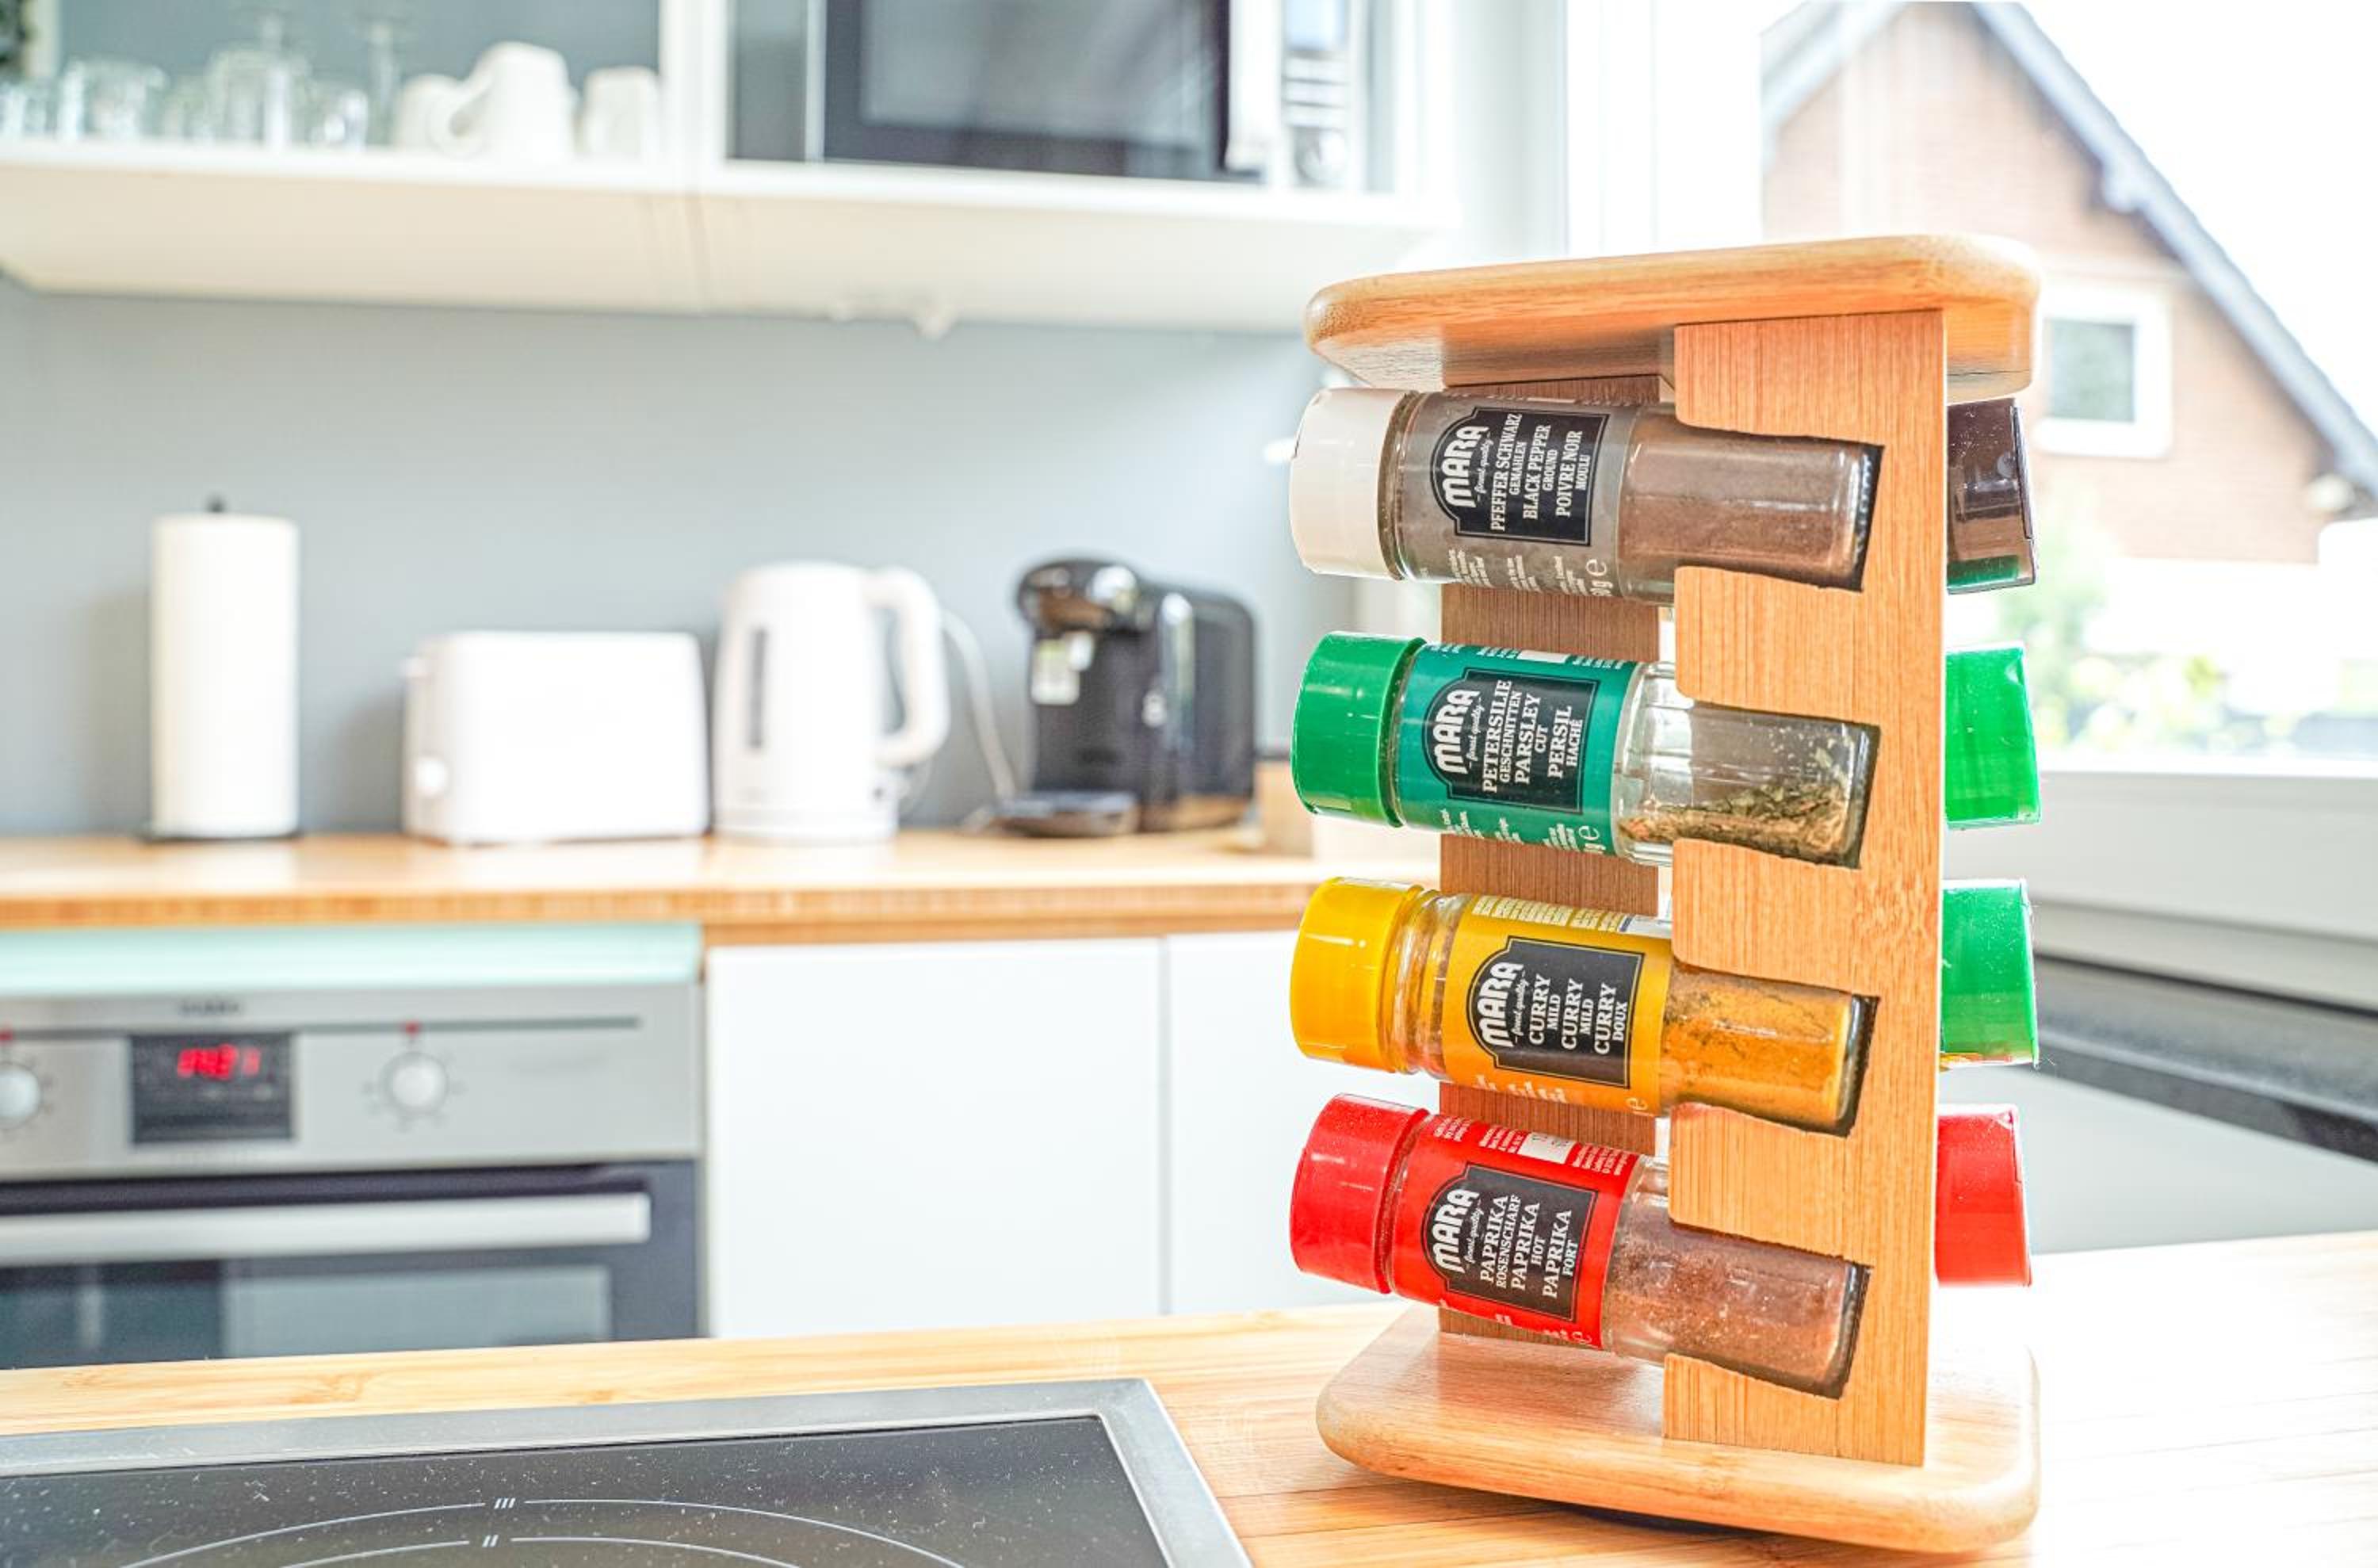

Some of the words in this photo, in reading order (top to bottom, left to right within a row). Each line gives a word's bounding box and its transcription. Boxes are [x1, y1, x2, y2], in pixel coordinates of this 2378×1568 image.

[1441, 426, 1489, 508] MARA
[1496, 413, 1523, 469] SCHWARZ
[1509, 441, 1527, 495] GEMAHLEN
[1527, 425, 1551, 471] PEPPER
[1543, 449, 1558, 491] GROUND
[1562, 430, 1583, 461] NOIR
[1491, 471, 1510, 530] PFEFFER
[1524, 472, 1541, 519] BLACK
[1556, 462, 1576, 517] POIVRE
[1576, 455, 1591, 491] MOULU
[1433, 689, 1481, 774] MARA
[1483, 679, 1512, 793] PETERSILIE
[1500, 690, 1523, 783] GESCHNITTEN
[1516, 692, 1542, 784] PARSLEY
[1535, 726, 1548, 753] CUT
[1548, 706, 1573, 778] PERSIL
[1566, 718, 1584, 767] HACHÉ
[1477, 962, 1524, 1047] MARA
[1530, 973, 1552, 1045] CURRY
[1547, 993, 1561, 1031] MILD
[1562, 977, 1584, 1050] CURRY
[1580, 999, 1594, 1035] MILD
[1595, 982, 1618, 1055] CURRY
[1611, 1001, 1628, 1042] DOUX
[1432, 1189, 1480, 1274] MARA
[1481, 1195, 1509, 1283] PAPRIKA
[1497, 1194, 1521, 1289] ROSENSCHARF
[1511, 1203, 1540, 1291] PAPRIKA
[1531, 1236, 1546, 1266] HOT
[1543, 1210, 1572, 1298] PAPRIKA
[1563, 1241, 1578, 1276] FORT
